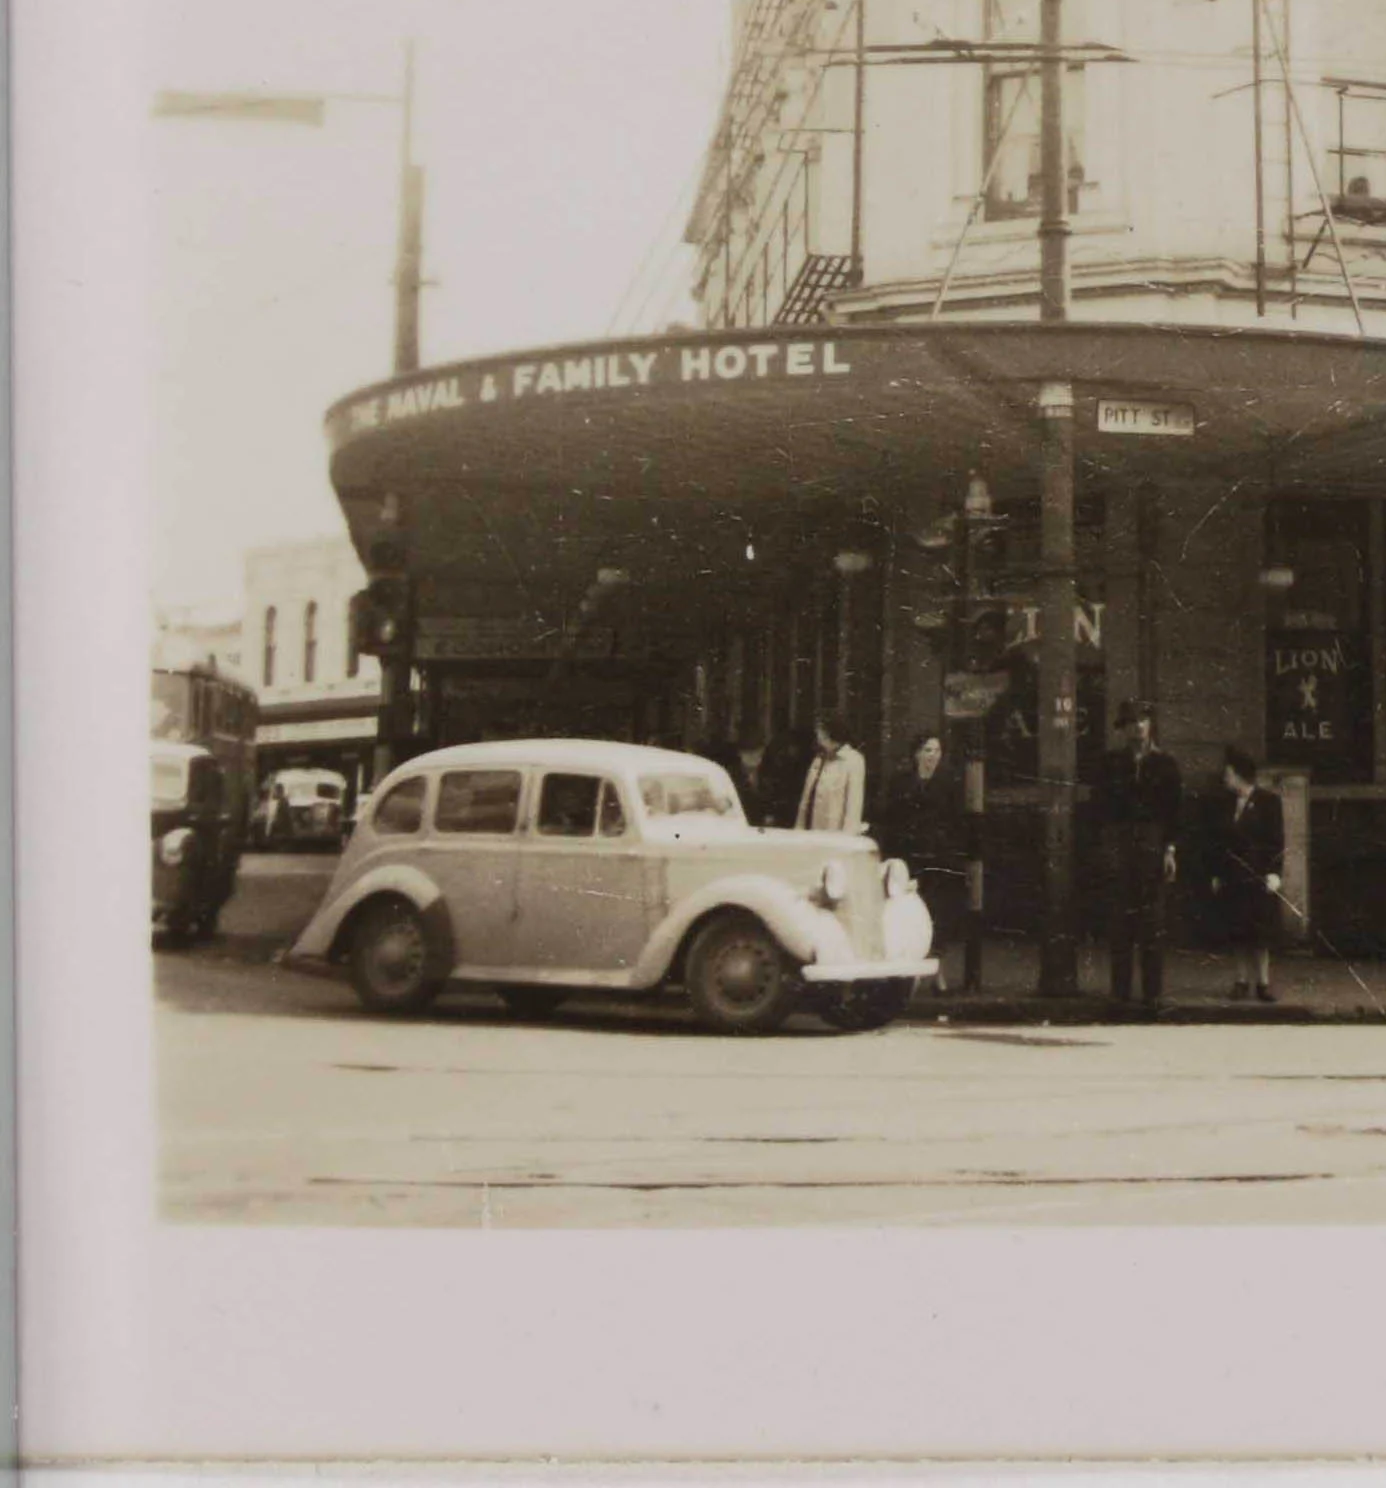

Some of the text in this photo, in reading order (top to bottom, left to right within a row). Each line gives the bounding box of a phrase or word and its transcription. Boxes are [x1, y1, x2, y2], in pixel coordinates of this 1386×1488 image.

[386, 377, 464, 422] NAVAL
[480, 373, 496, 403] &
[513, 352, 658, 397] FAMILY
[681, 342, 851, 382] HOTEL
[1103, 406, 1171, 427] PITT ST
[1275, 648, 1339, 676] LION
[1282, 721, 1334, 740] ALE
